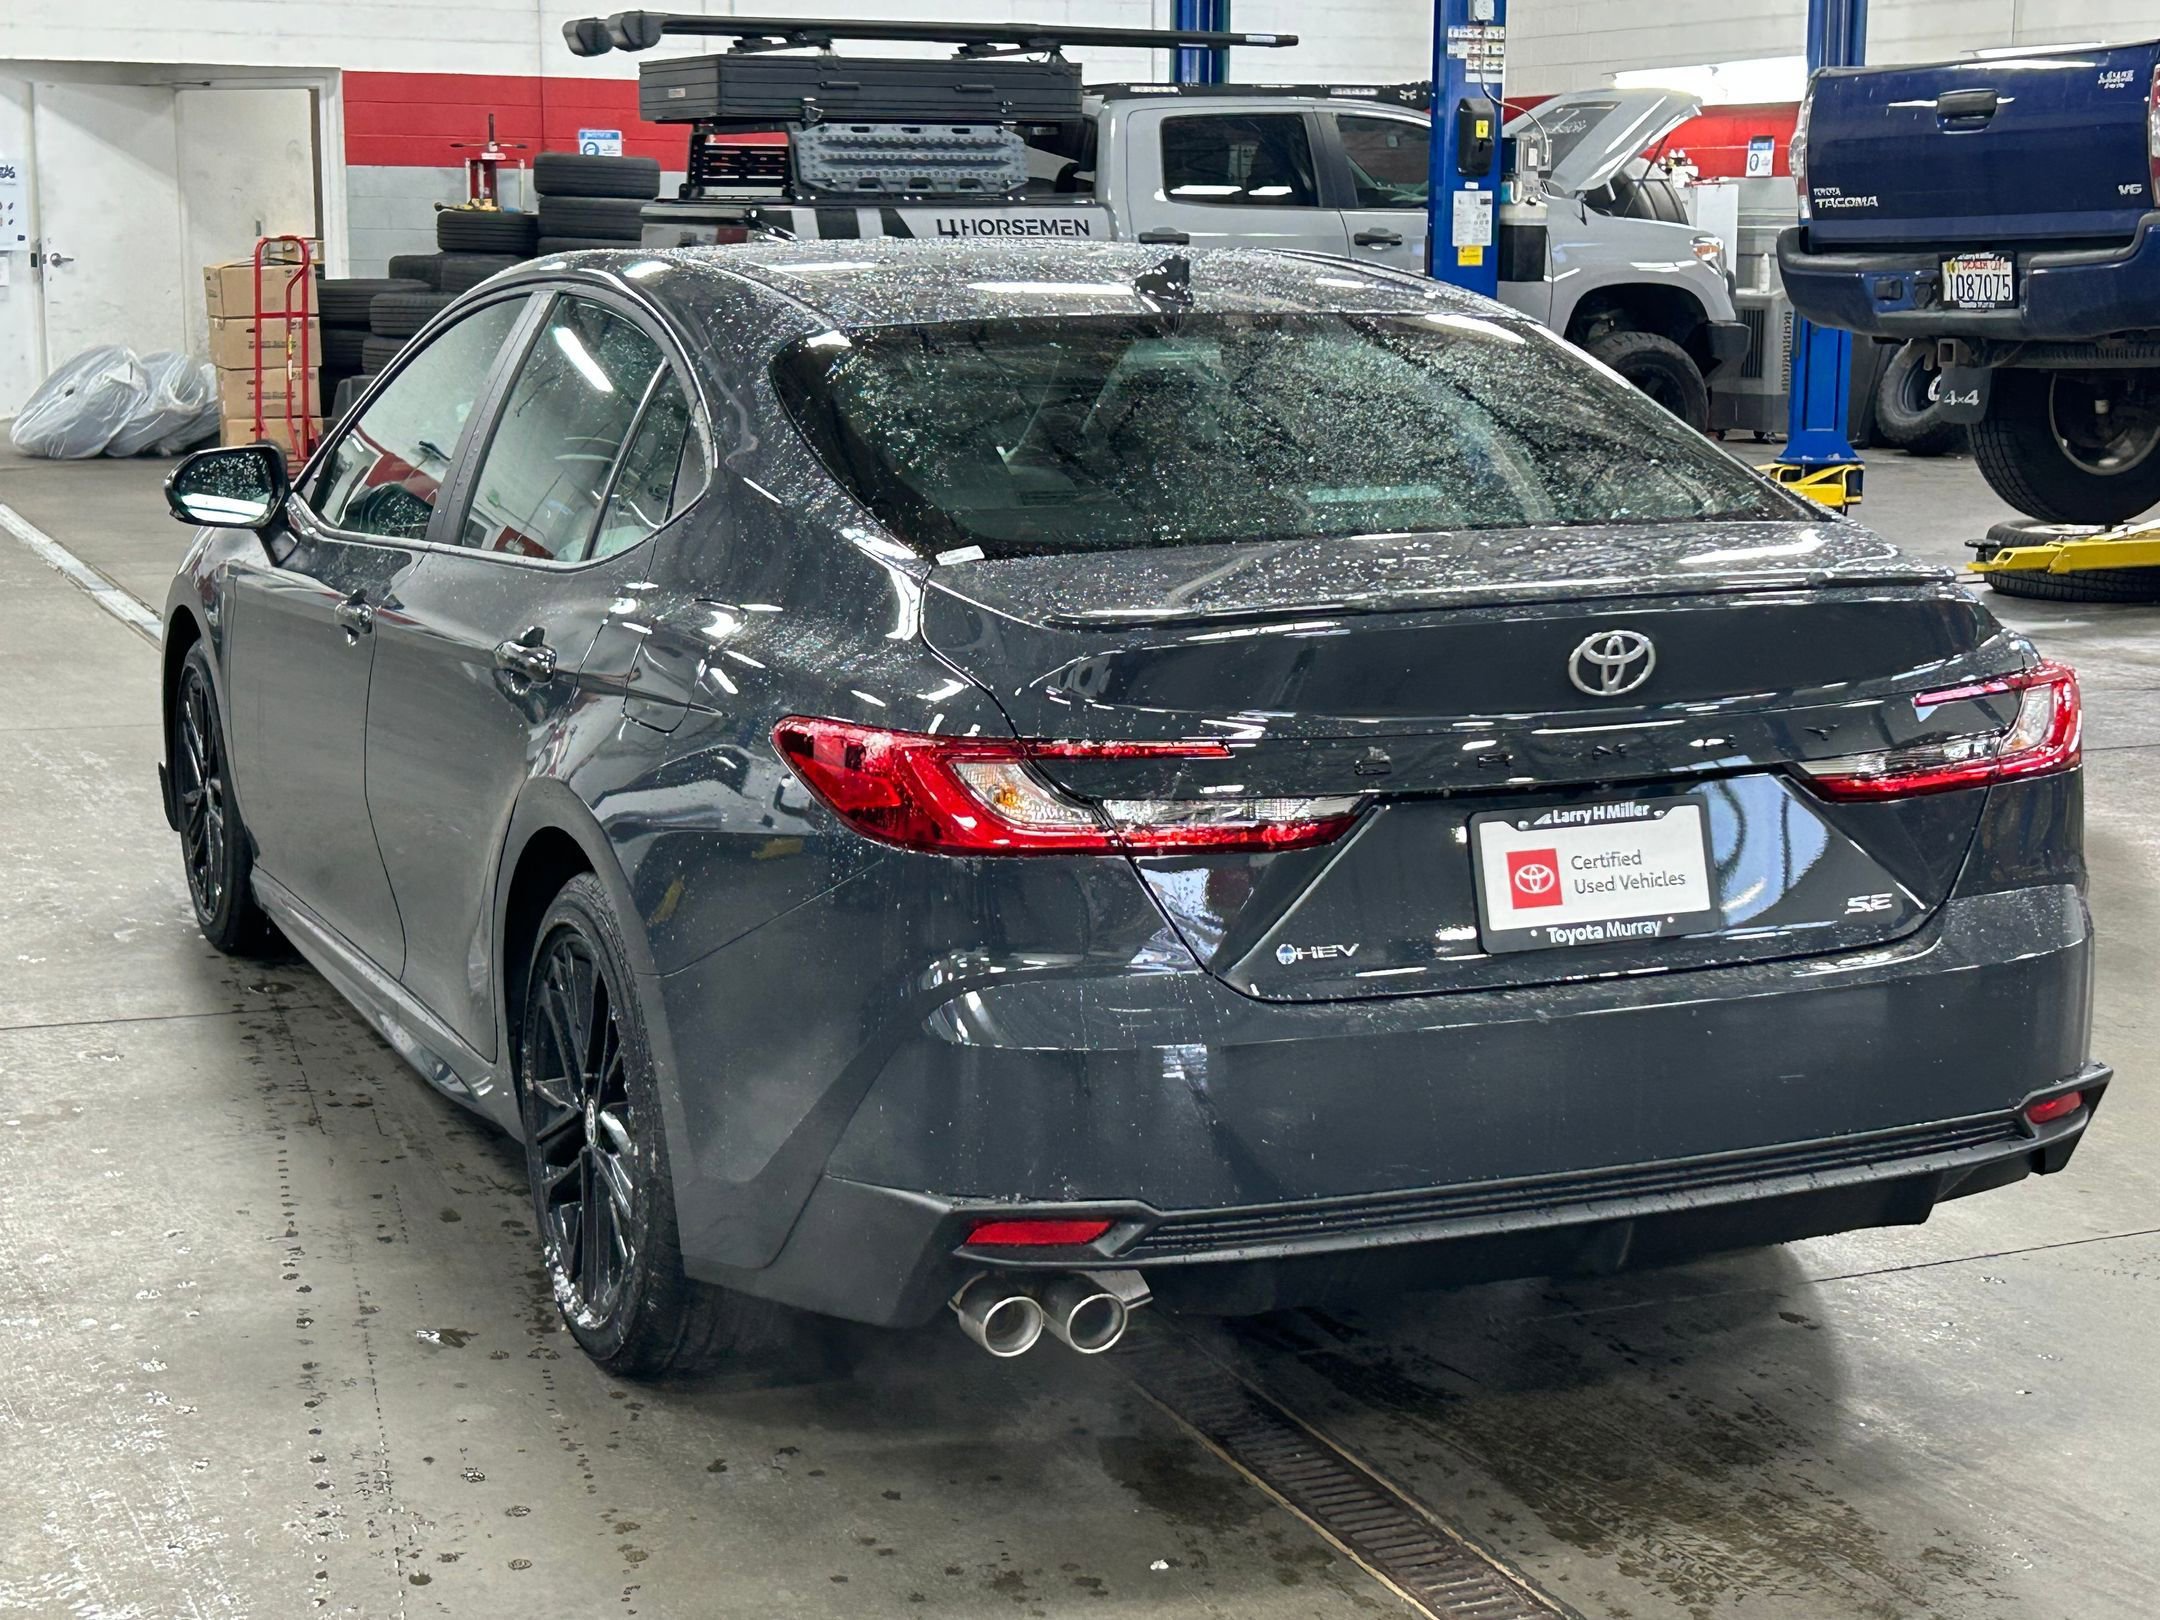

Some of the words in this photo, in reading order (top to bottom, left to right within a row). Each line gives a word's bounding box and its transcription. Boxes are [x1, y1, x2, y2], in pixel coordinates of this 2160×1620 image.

[2117, 183, 2143, 195] V6
[1814, 195, 1879, 209] TACOMA
[1948, 273, 2011, 301] 1087075
[1552, 807, 1592, 825] Larry
[1593, 805, 1605, 820] H
[1606, 801, 1650, 819] Miller
[1570, 849, 1643, 871] Certified
[1573, 875, 1617, 894] Used
[1618, 871, 1686, 891] Vehicles
[1844, 892, 1893, 915] SE
[1545, 926, 1604, 945] Toyota
[1605, 920, 1662, 937] Murray
[1296, 943, 1360, 960] HEV
